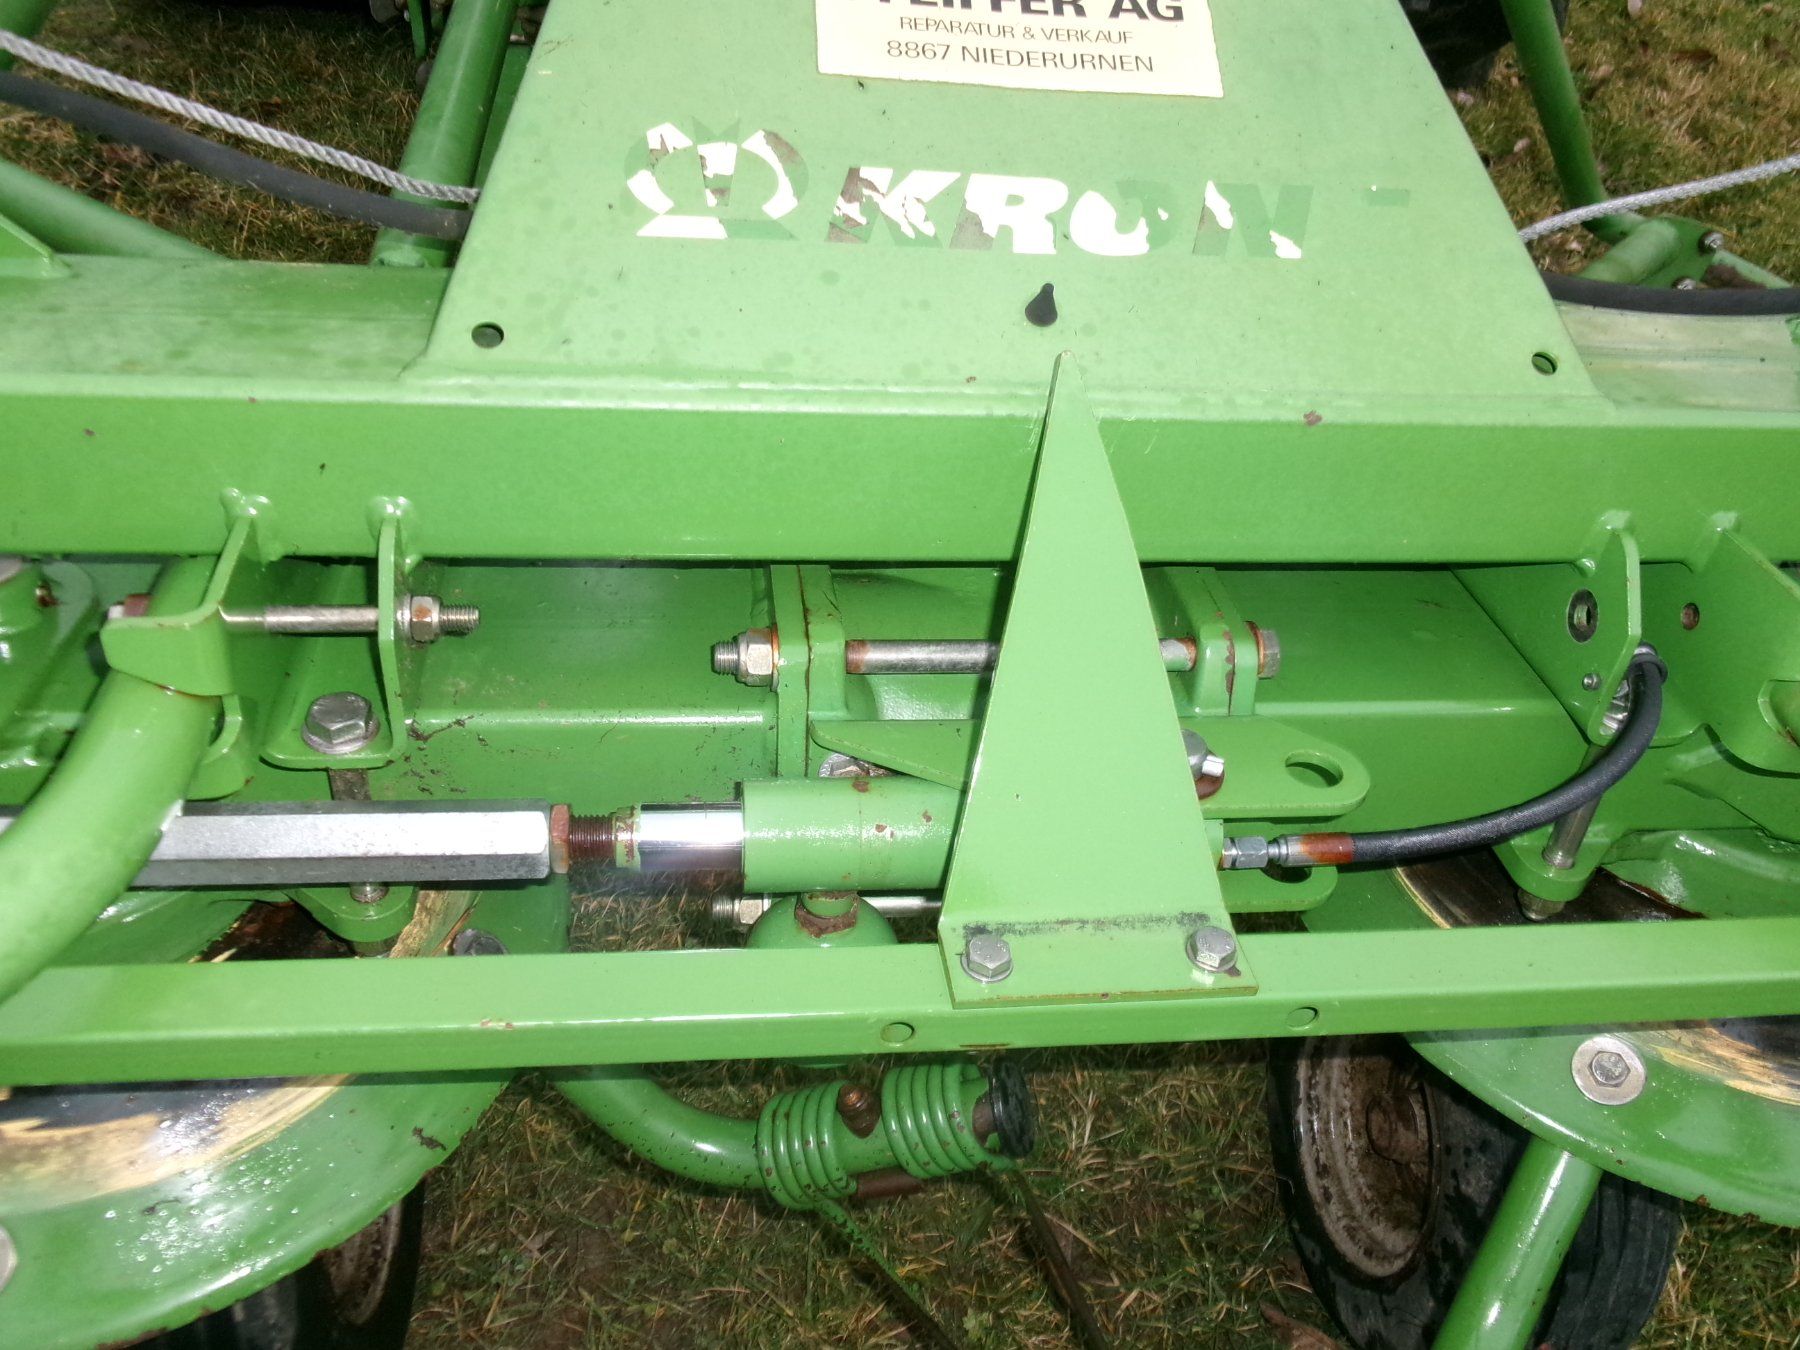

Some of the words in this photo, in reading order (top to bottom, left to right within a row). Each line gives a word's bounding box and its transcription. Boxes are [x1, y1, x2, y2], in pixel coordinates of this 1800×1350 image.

[1108, 0, 1184, 21] AG
[899, 16, 1015, 40] REPARATUR
[1023, 26, 1036, 39] &
[1041, 27, 1134, 44] VERKAUF
[887, 40, 951, 61] 8867
[961, 45, 1154, 73] NIEDERURNEN
[824, 166, 1410, 260] KRON
